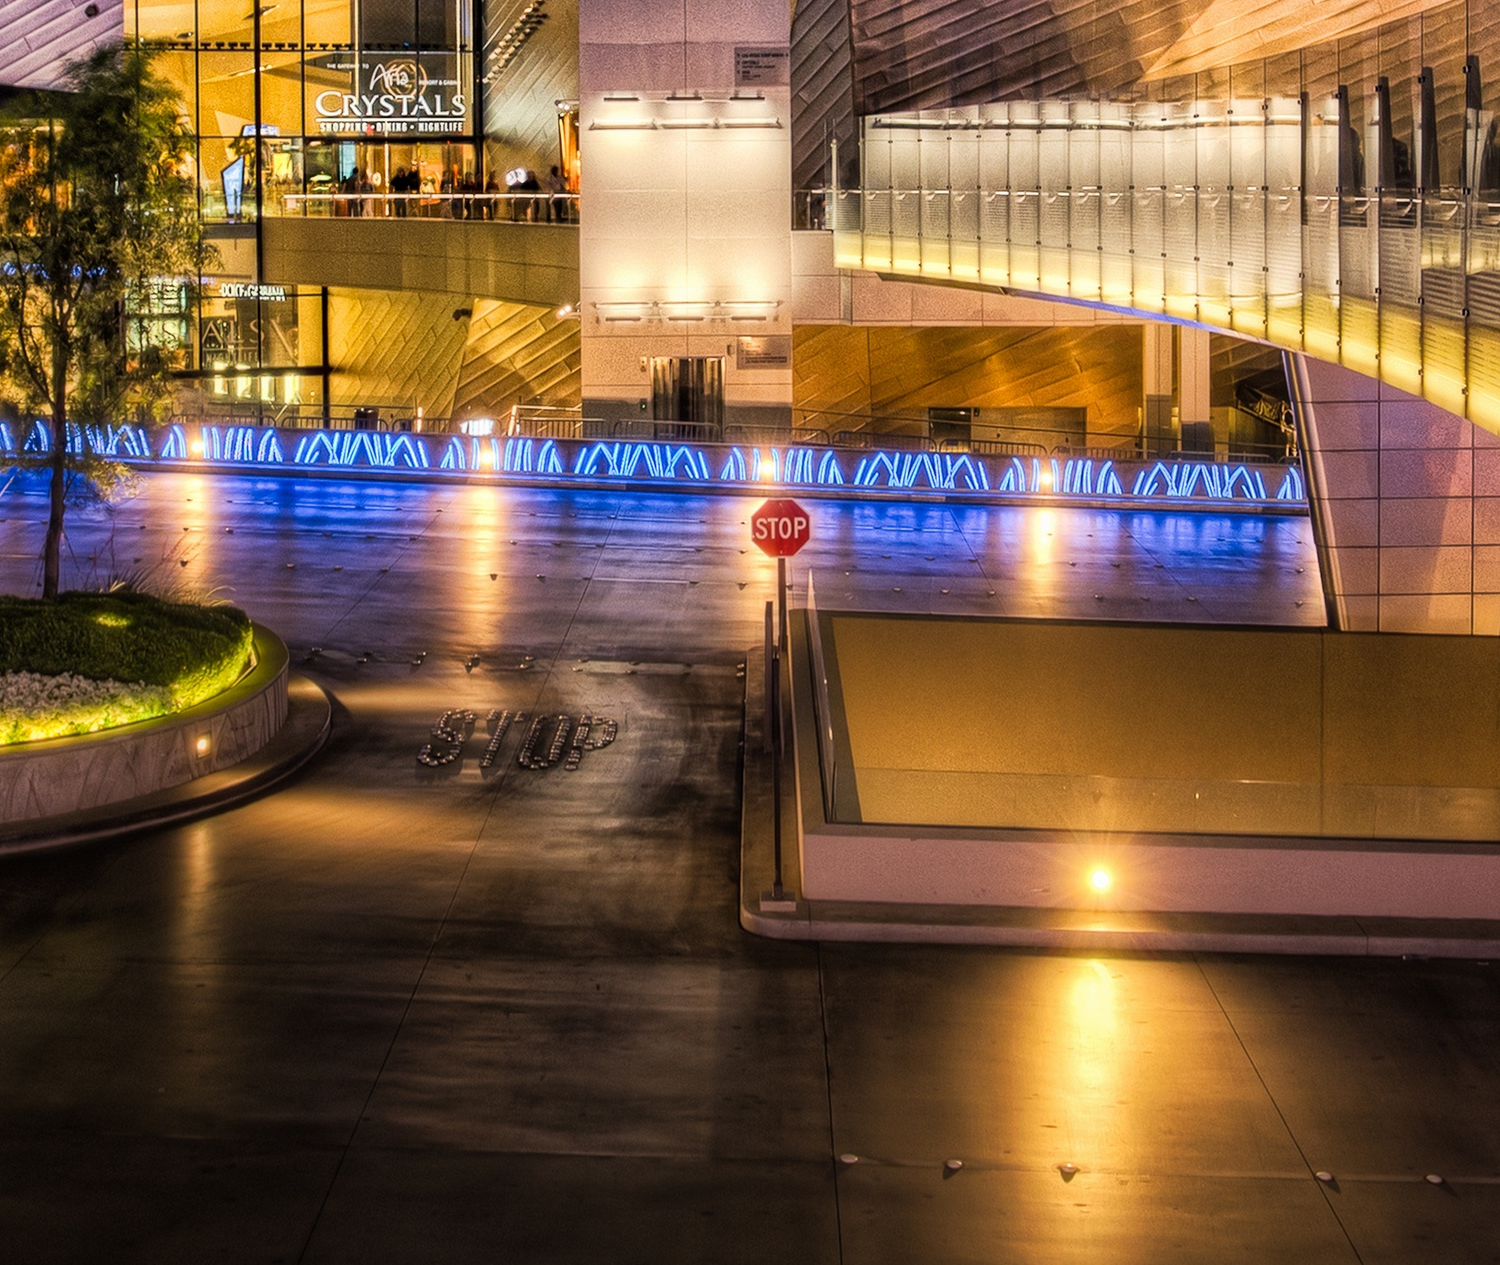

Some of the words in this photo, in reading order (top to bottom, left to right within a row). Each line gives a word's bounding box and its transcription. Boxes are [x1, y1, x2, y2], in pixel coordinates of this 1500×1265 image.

[369, 62, 409, 91] Aria
[315, 90, 467, 117] CRYSTALS
[319, 121, 368, 132] SHOPPING
[375, 122, 408, 132] DINING
[418, 122, 464, 133] NIGHTLIFE
[755, 517, 807, 540] STOP
[417, 708, 618, 771] STOP
